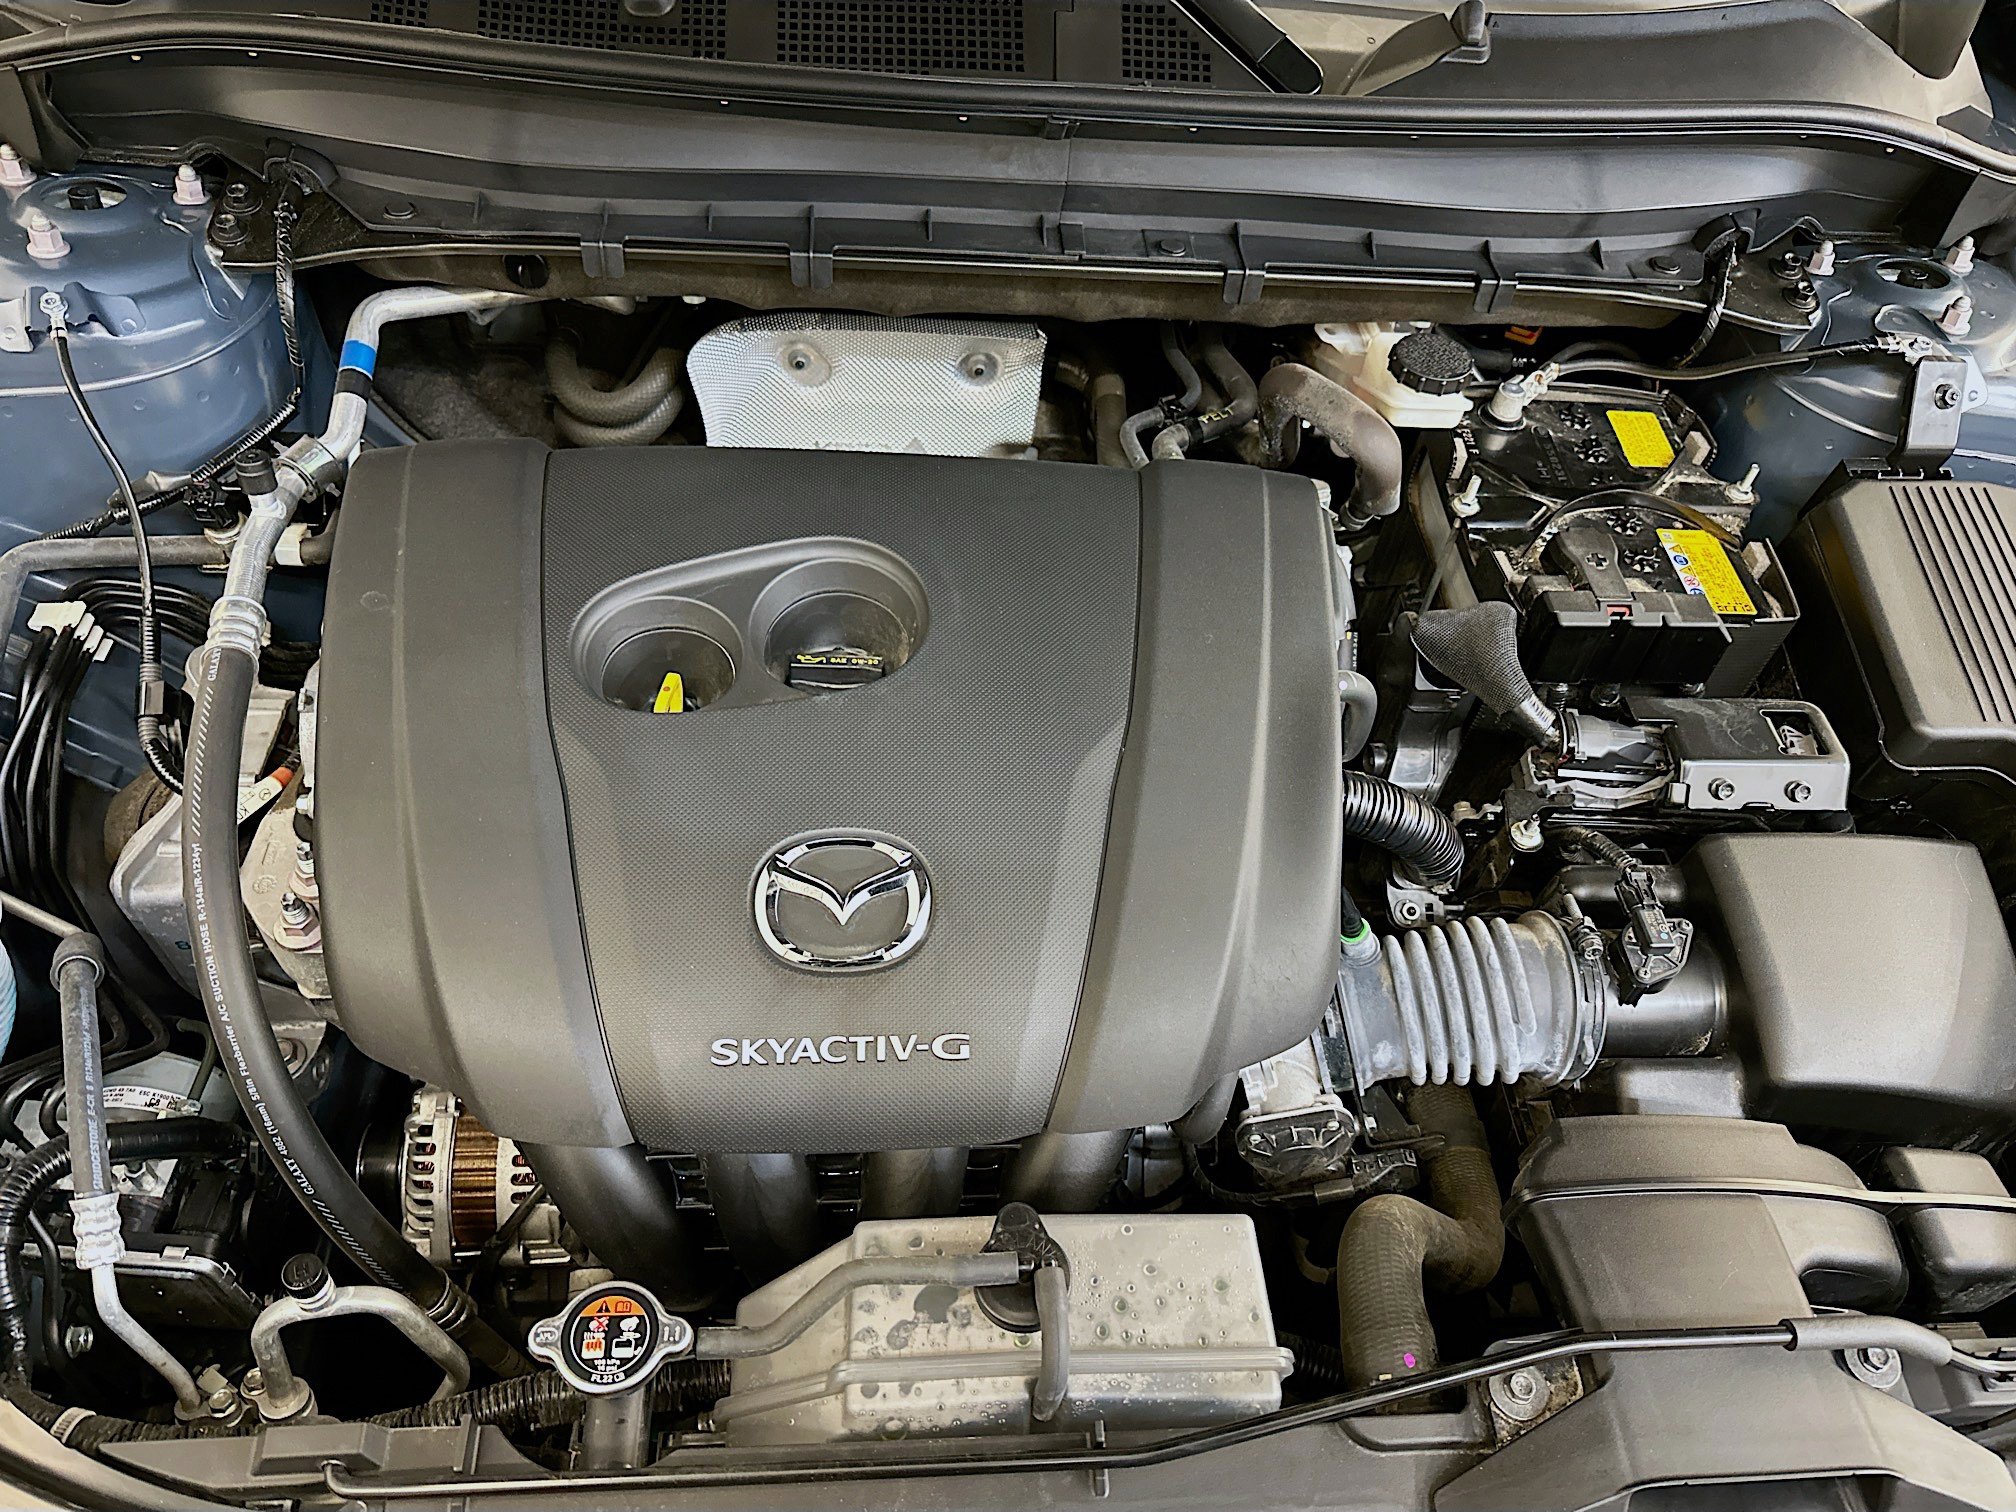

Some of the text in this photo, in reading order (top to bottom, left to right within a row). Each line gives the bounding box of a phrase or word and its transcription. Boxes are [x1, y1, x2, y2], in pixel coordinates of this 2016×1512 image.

[191, 843, 208, 923] R-134a/R-1234yf
[199, 922, 213, 953] HOSE
[205, 953, 224, 1002] SUCTION
[217, 1004, 231, 1022] A/C
[225, 1025, 250, 1077] Flexbarrier
[710, 1033, 971, 1067] SKYACTIV-G
[255, 1102, 279, 1136] (16mm)
[283, 1157, 315, 1196] GALAXY
[663, 1325, 681, 1342] 1.1
